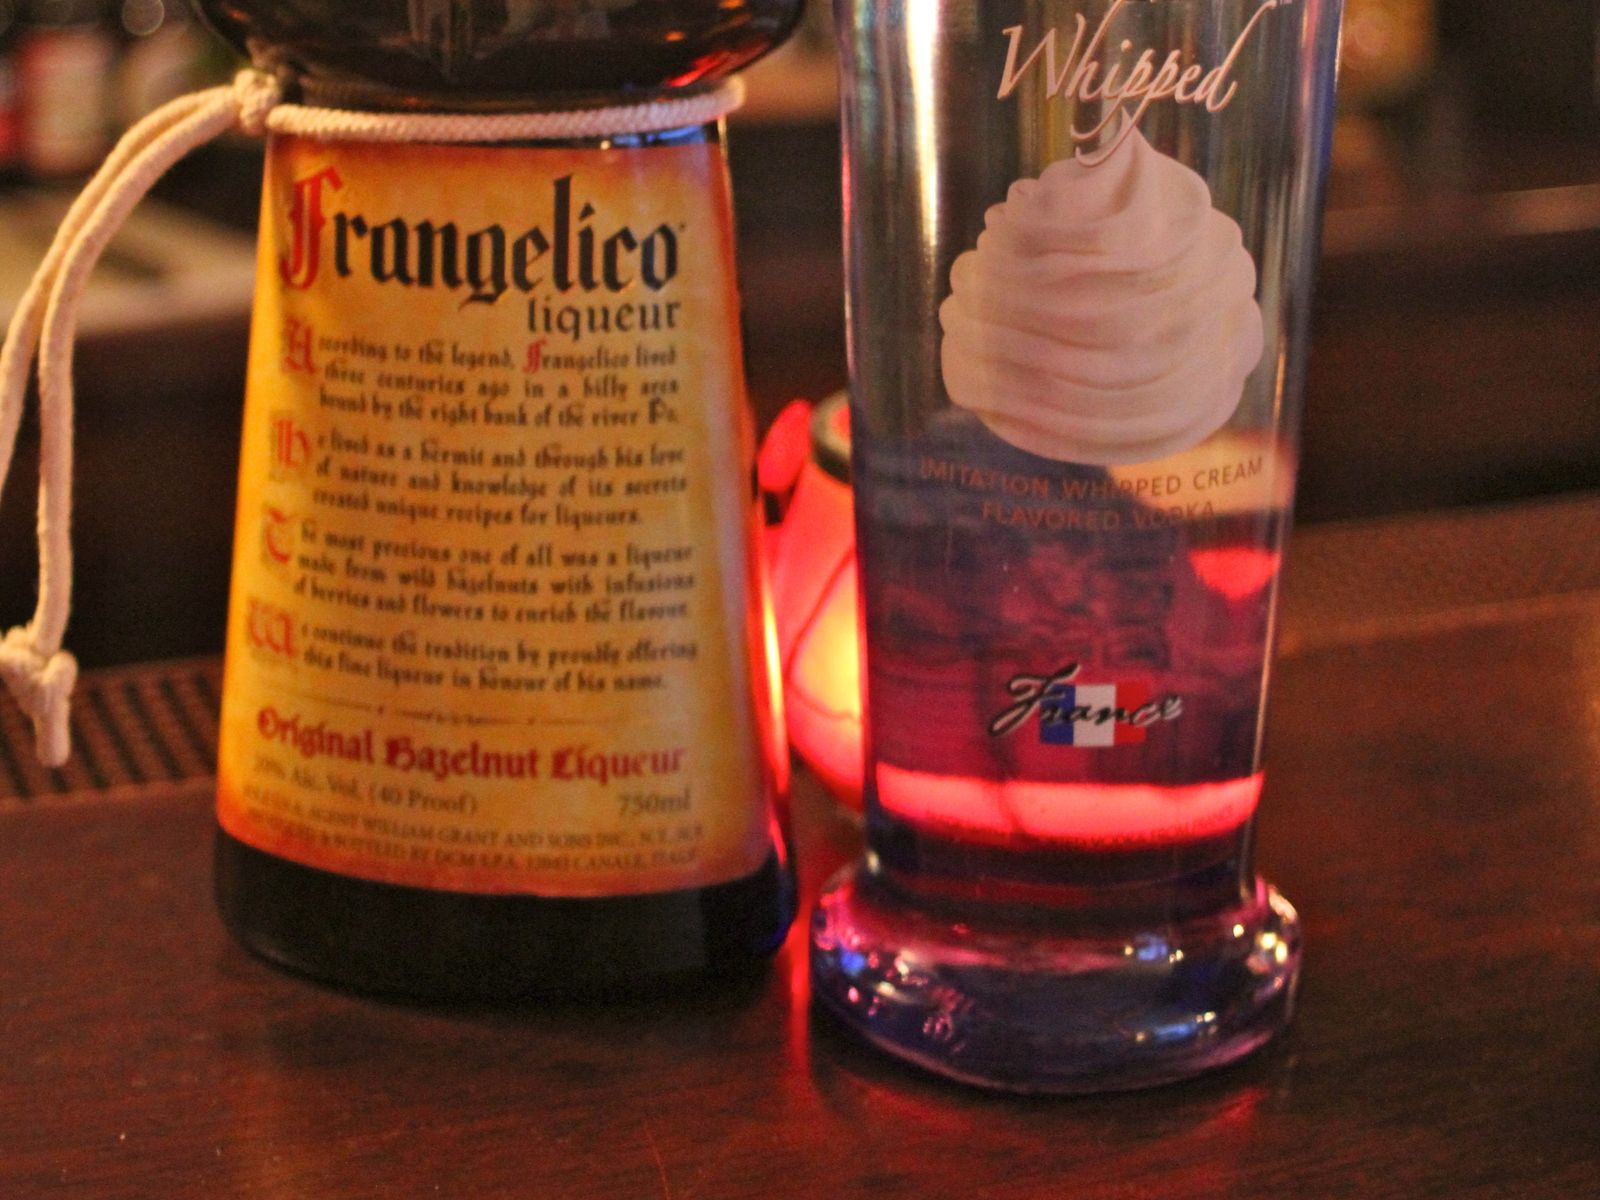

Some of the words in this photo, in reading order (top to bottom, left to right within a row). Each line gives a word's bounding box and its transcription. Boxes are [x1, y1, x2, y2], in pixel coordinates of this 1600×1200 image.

[279, 165, 679, 312] Frangelico
[527, 295, 682, 342] liqueur
[524, 378, 545, 399] in
[920, 456, 1050, 498] IMITATION
[1192, 456, 1264, 491] CREAM
[987, 662, 1183, 737] France
[256, 705, 375, 766] Original
[384, 735, 539, 782] Hazelnut
[550, 743, 685, 787] Liqueur
